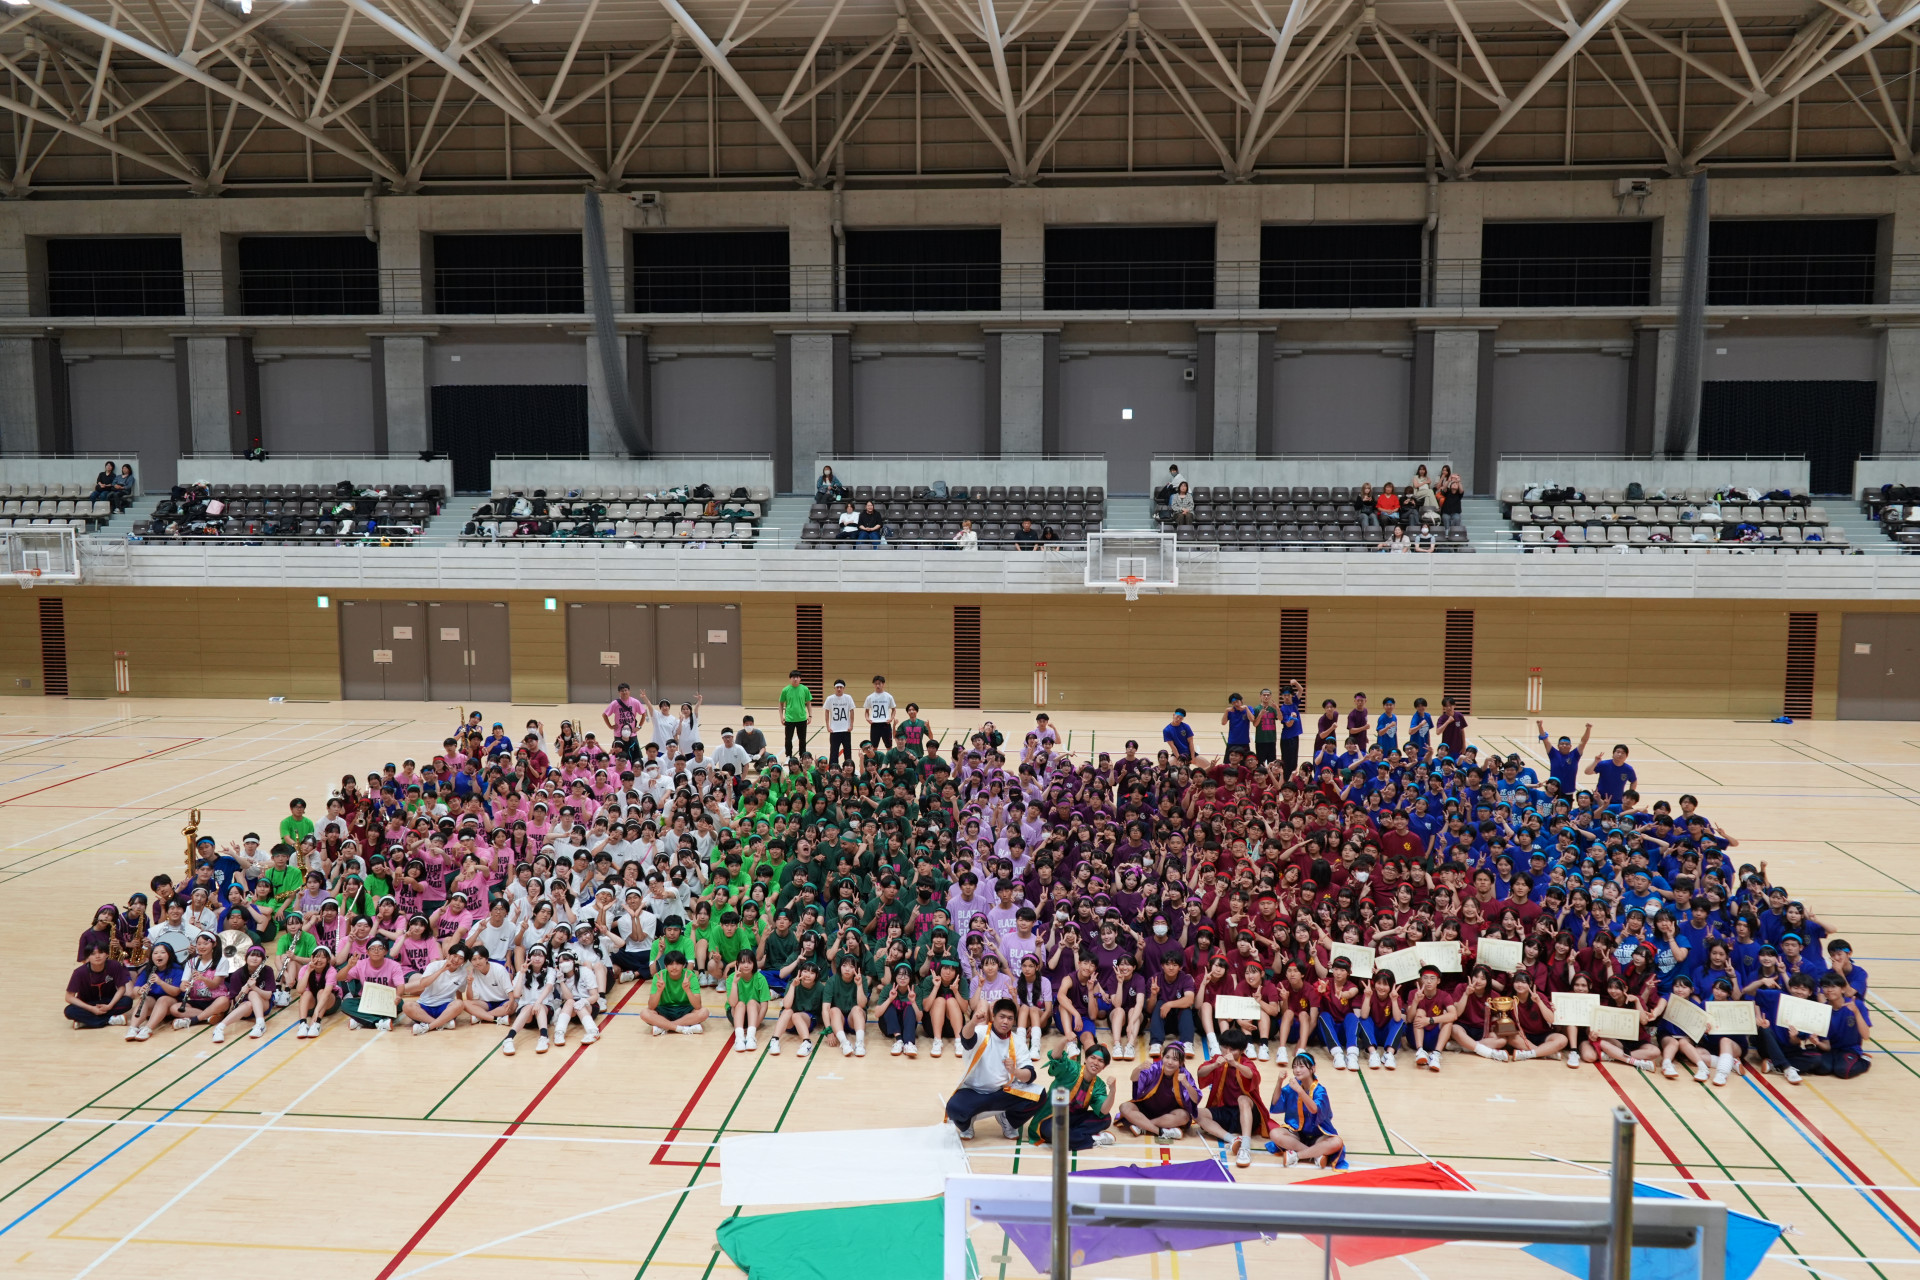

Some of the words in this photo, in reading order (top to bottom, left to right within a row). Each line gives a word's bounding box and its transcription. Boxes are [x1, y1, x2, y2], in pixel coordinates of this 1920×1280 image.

[833, 708, 847, 721] 3A
[873, 705, 886, 718] 3A
[440, 919, 459, 930] WEAR
[998, 919, 1016, 928] BLAZE
[406, 948, 428, 957] WEAR
[981, 990, 1002, 1000] BLAZE
